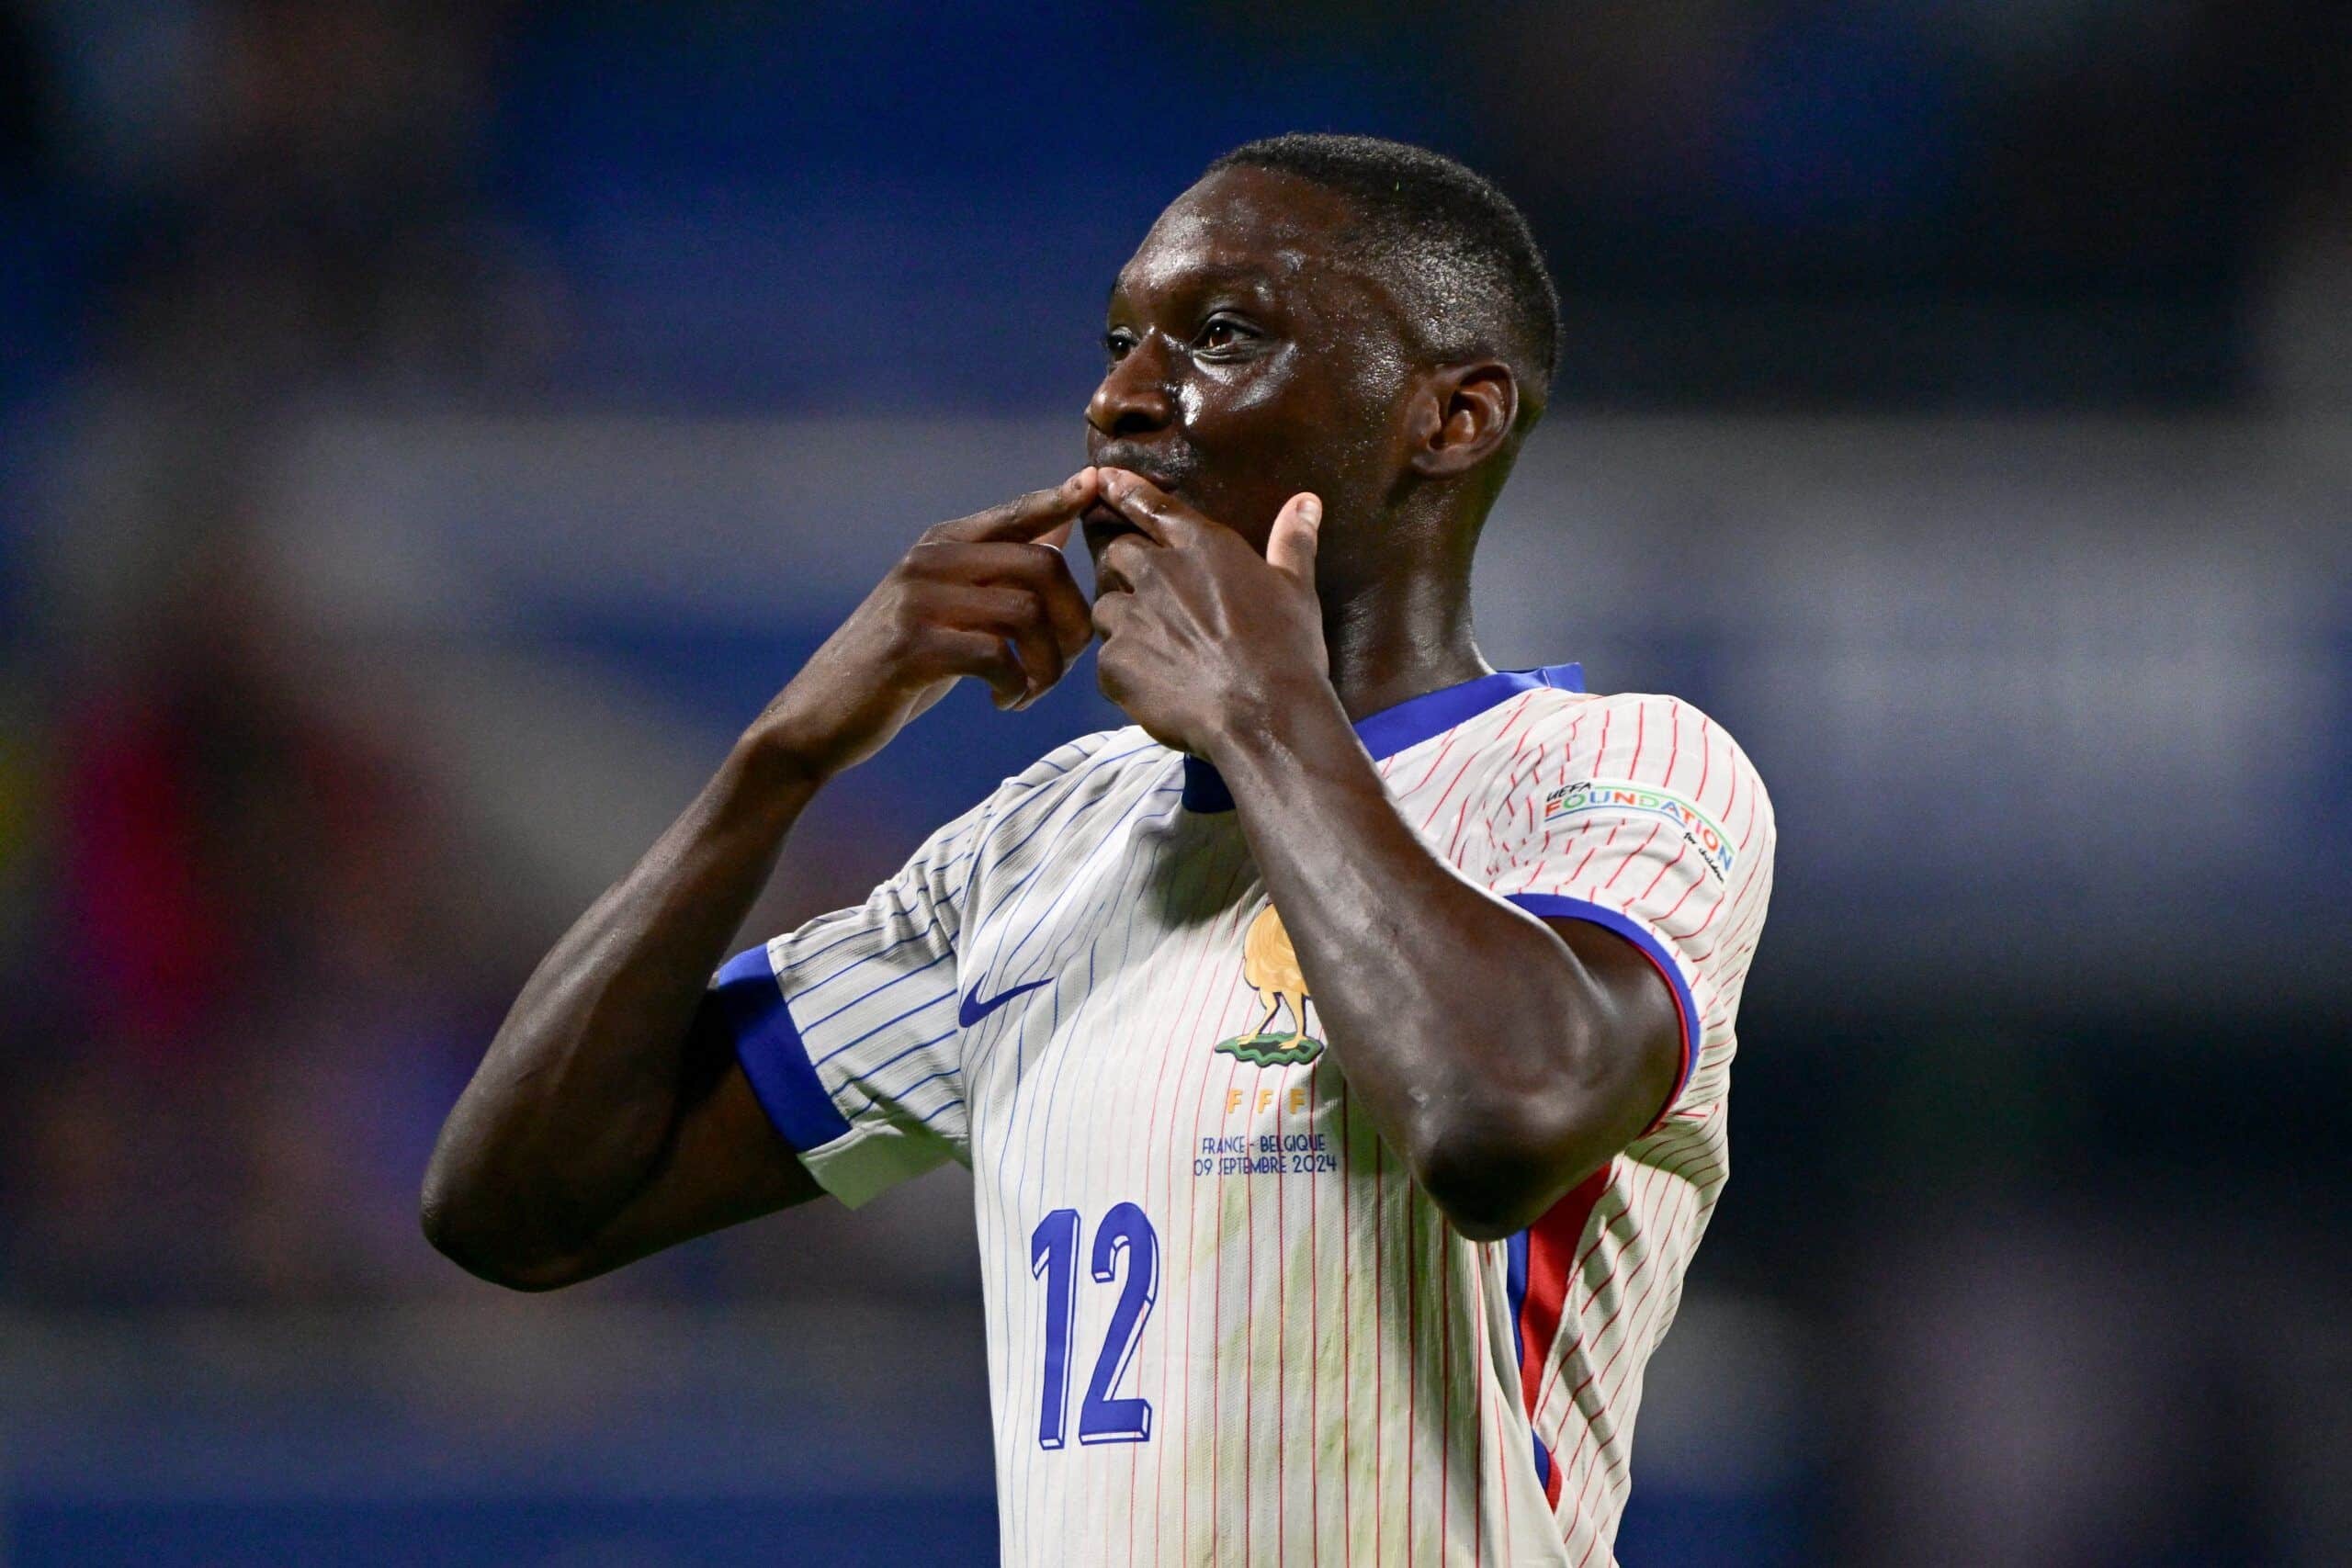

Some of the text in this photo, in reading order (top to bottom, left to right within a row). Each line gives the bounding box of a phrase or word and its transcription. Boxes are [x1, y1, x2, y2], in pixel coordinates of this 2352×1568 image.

[1546, 782, 1591, 802] UEFA
[1544, 791, 1736, 872] FOUNDATION
[1202, 1136, 1247, 1155] FRANCE
[1260, 1134, 1326, 1153] BELGIQUE
[1194, 1155, 1337, 1177] 09 SEPTEMBRE 2024
[1031, 1201, 1159, 1450] 12
